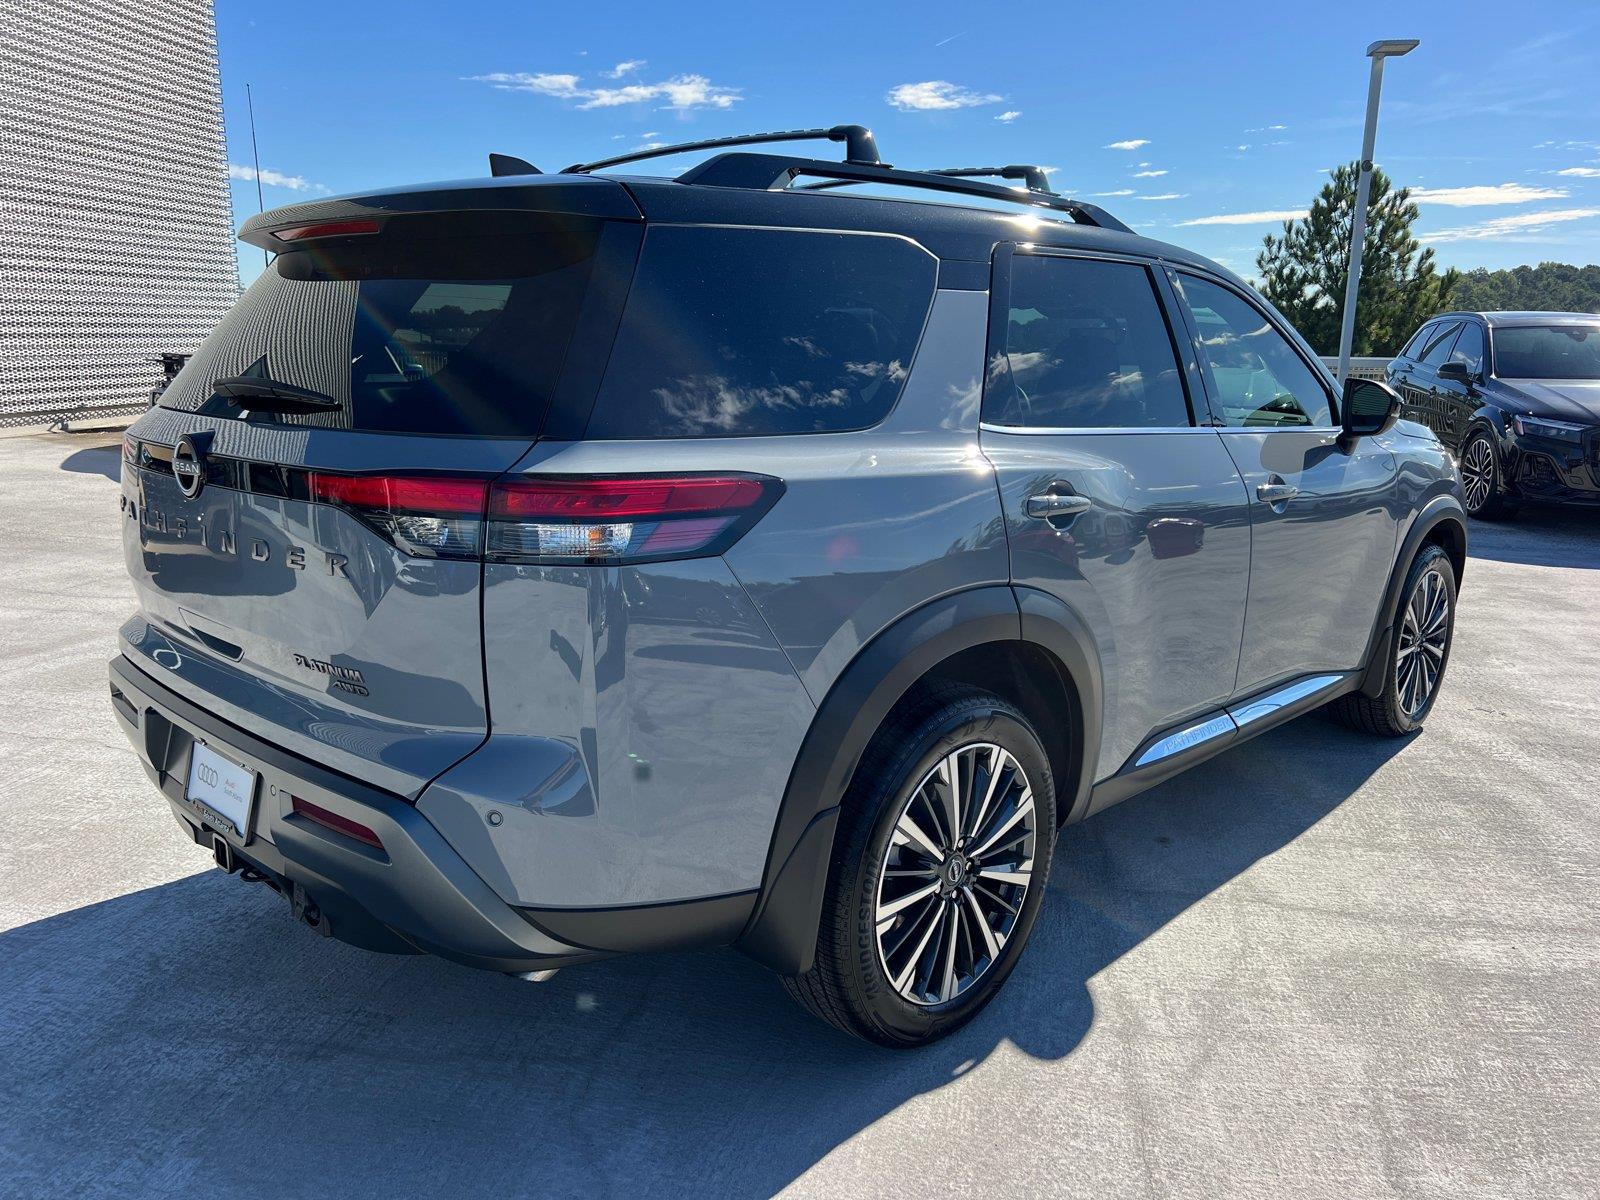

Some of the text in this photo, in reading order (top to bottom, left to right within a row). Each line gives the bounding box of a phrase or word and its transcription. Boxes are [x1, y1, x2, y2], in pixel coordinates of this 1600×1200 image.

[173, 460, 200, 474] SSAN
[119, 493, 351, 579] PATHFINDER
[292, 653, 364, 683] PLATINUM
[332, 681, 369, 697] AWD
[1163, 718, 1232, 753] PATHFINDER
